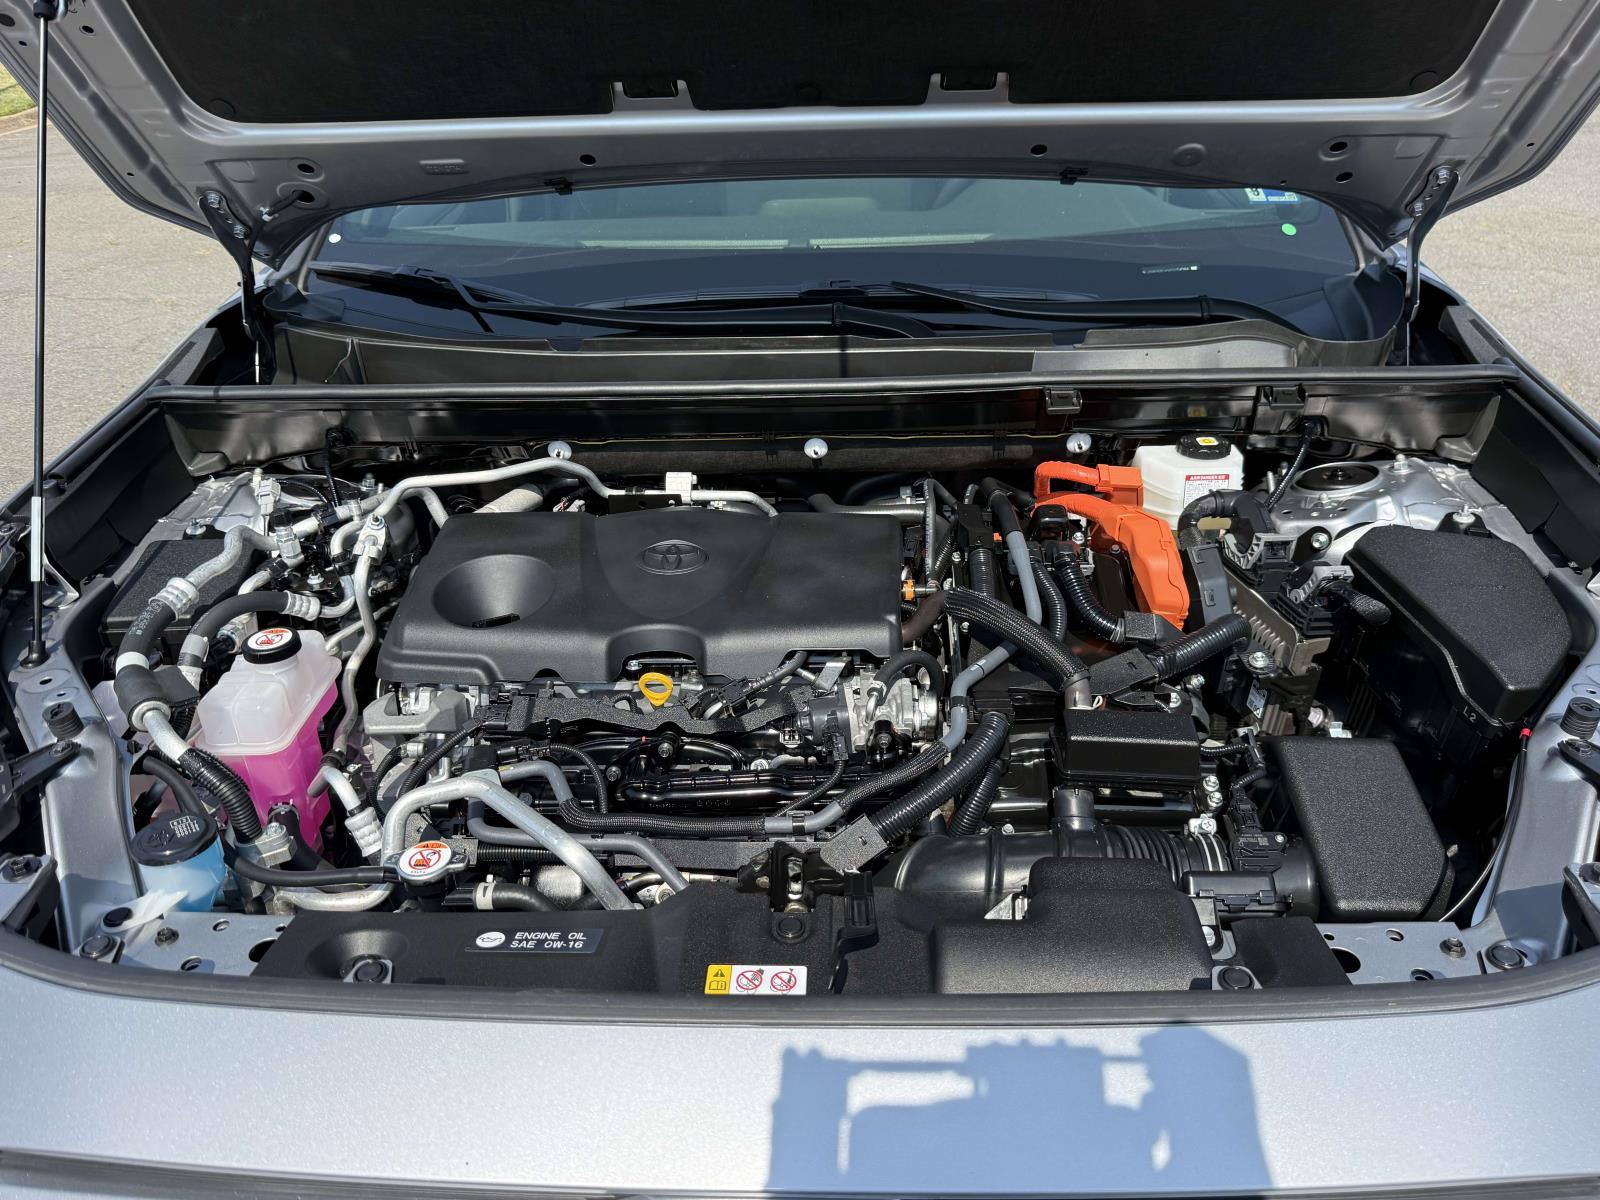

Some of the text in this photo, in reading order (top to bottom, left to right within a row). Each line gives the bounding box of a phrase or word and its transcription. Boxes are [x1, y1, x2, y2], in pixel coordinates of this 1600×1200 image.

[514, 931, 587, 940] ENGINE OIL
[510, 940, 584, 948] SAE 0W-16
